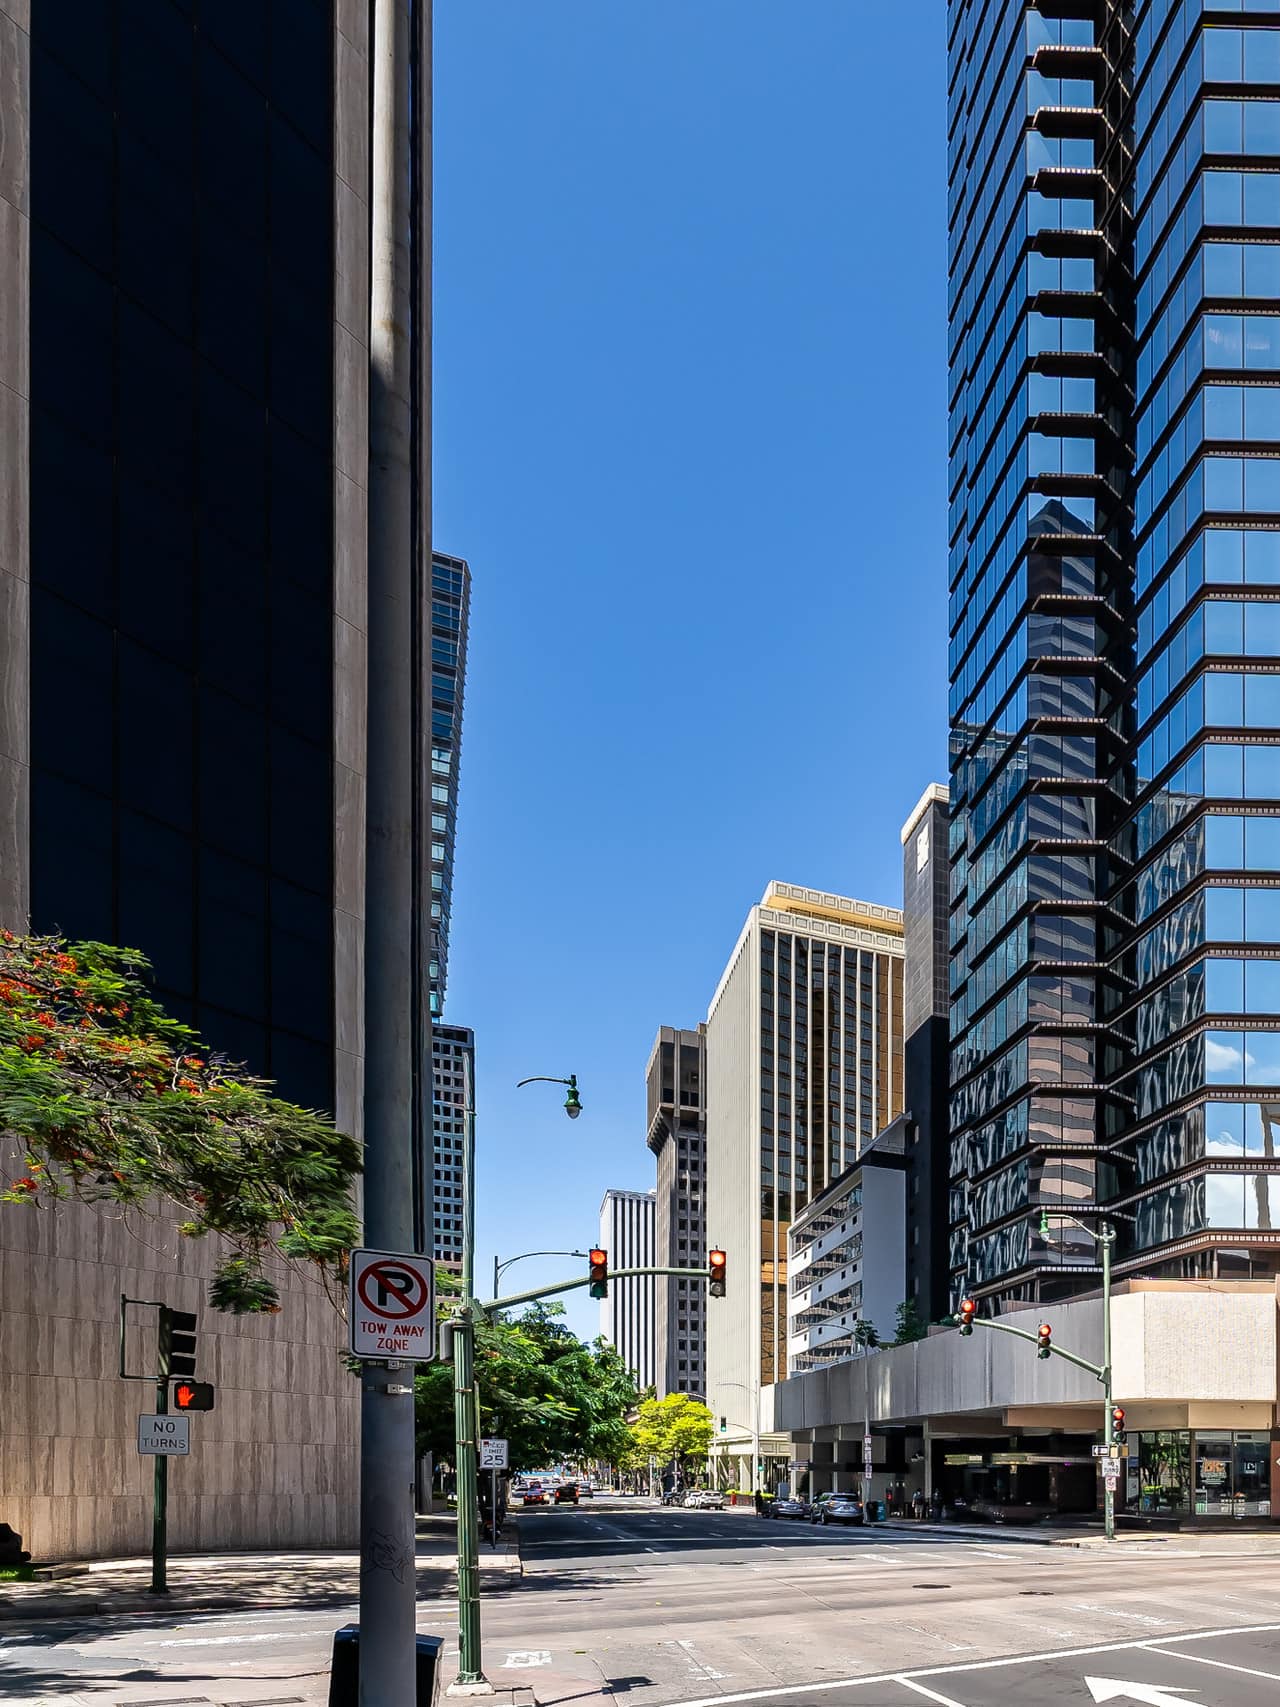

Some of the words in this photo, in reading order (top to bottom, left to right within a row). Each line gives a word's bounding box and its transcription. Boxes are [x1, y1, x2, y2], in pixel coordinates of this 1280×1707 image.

[361, 1321, 387, 1334] TOW
[393, 1325, 425, 1337] AWAY
[377, 1338, 409, 1350] ZONE
[153, 1421, 176, 1433] NO
[143, 1437, 186, 1449] TURNS
[483, 1455, 505, 1466] 25
